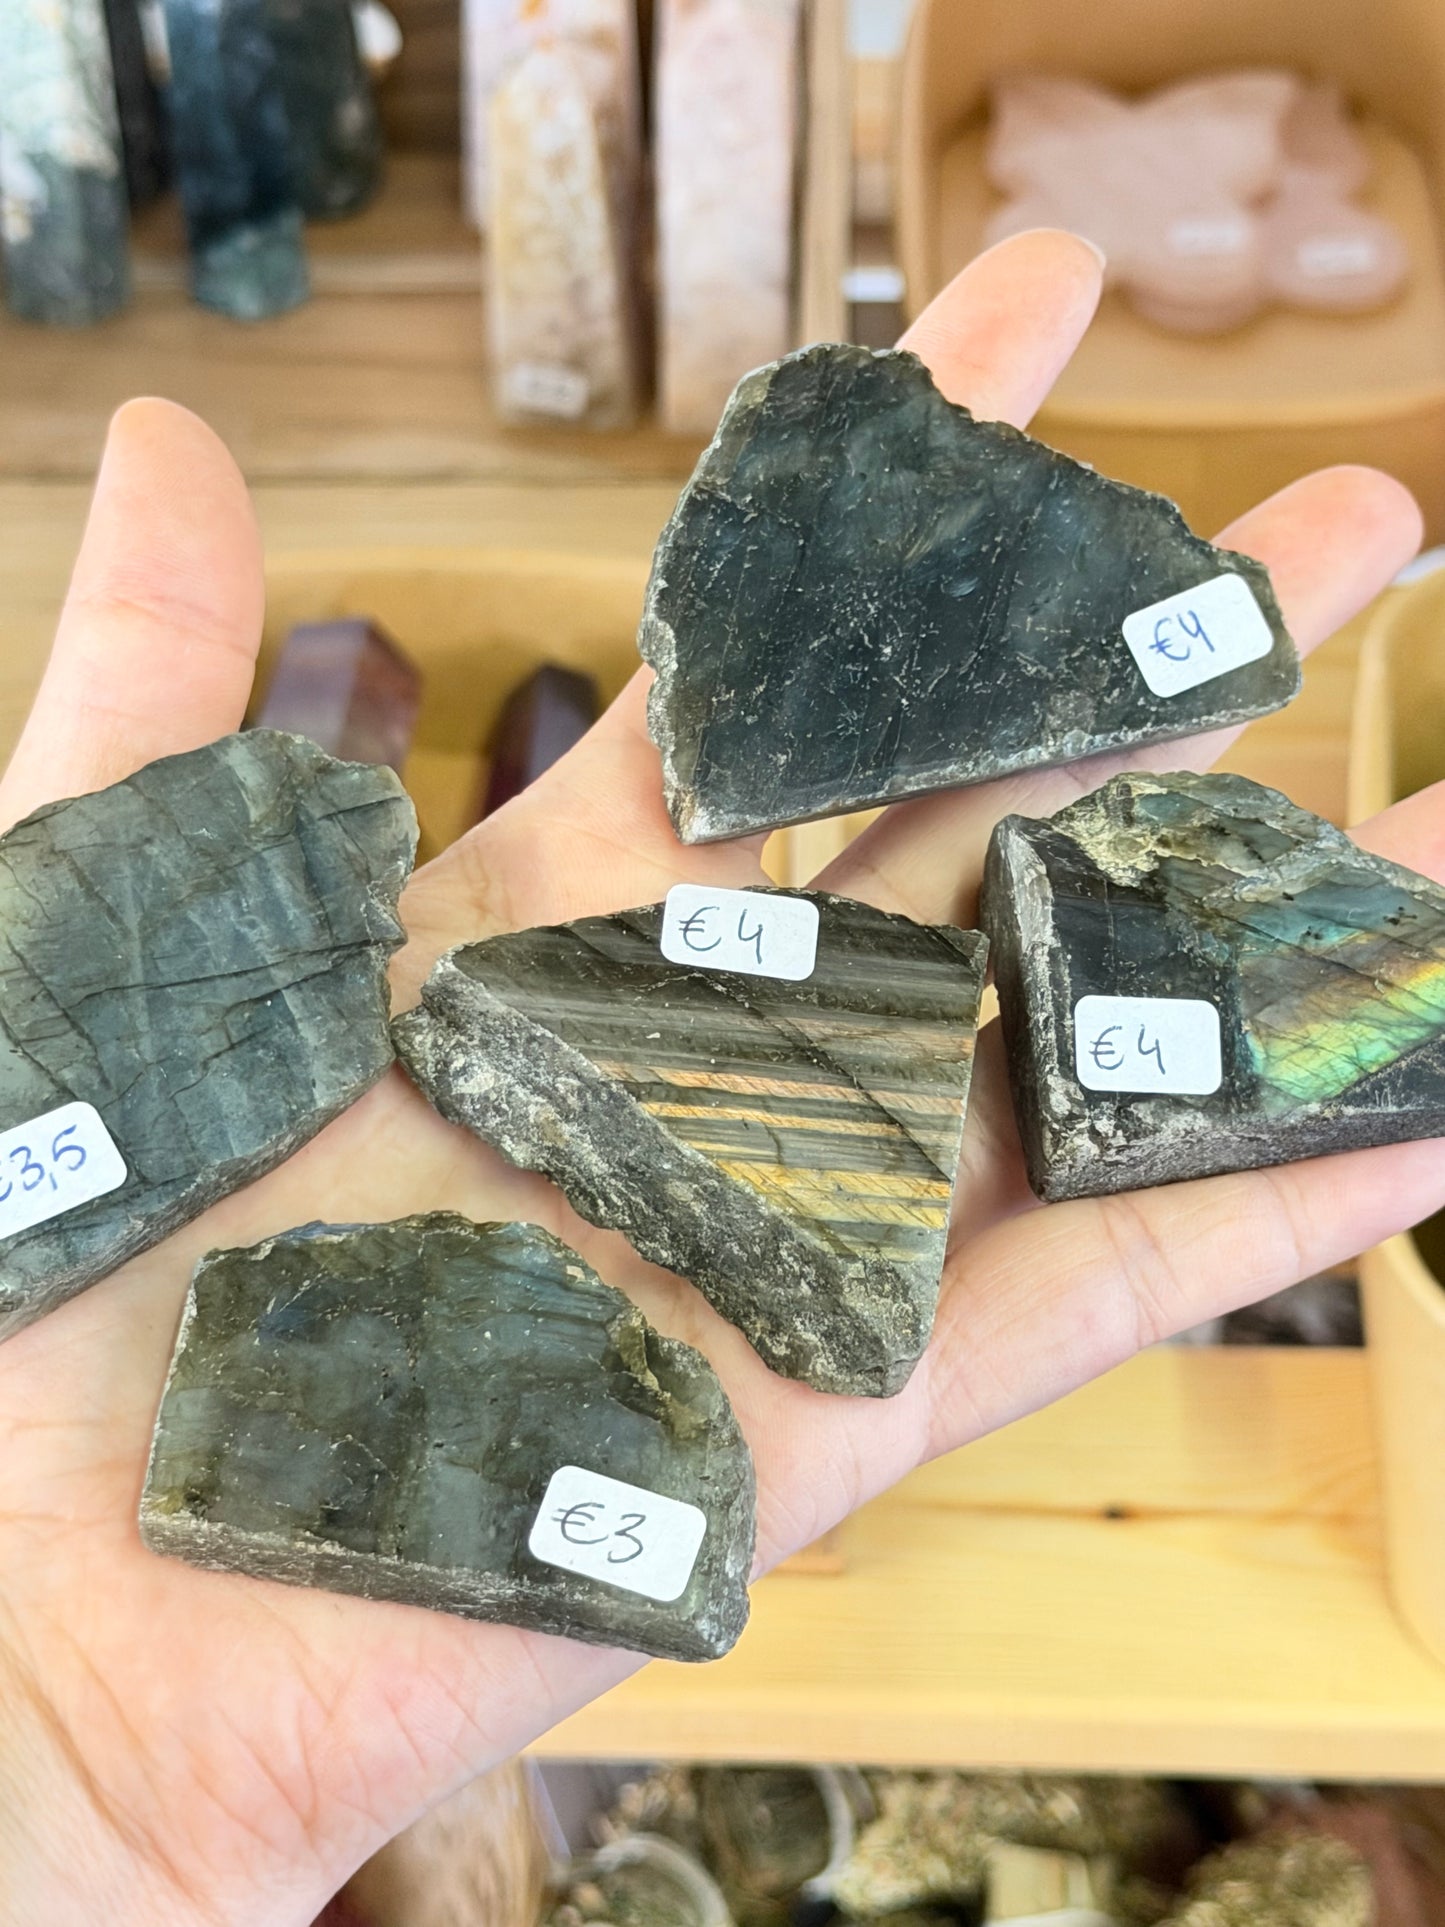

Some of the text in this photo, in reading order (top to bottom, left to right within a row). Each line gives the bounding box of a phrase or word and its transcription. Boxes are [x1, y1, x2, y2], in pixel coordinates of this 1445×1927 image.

[1148, 609, 1215, 661] €4
[1088, 1024, 1166, 1075] €4
[551, 1502, 646, 1563] €3
